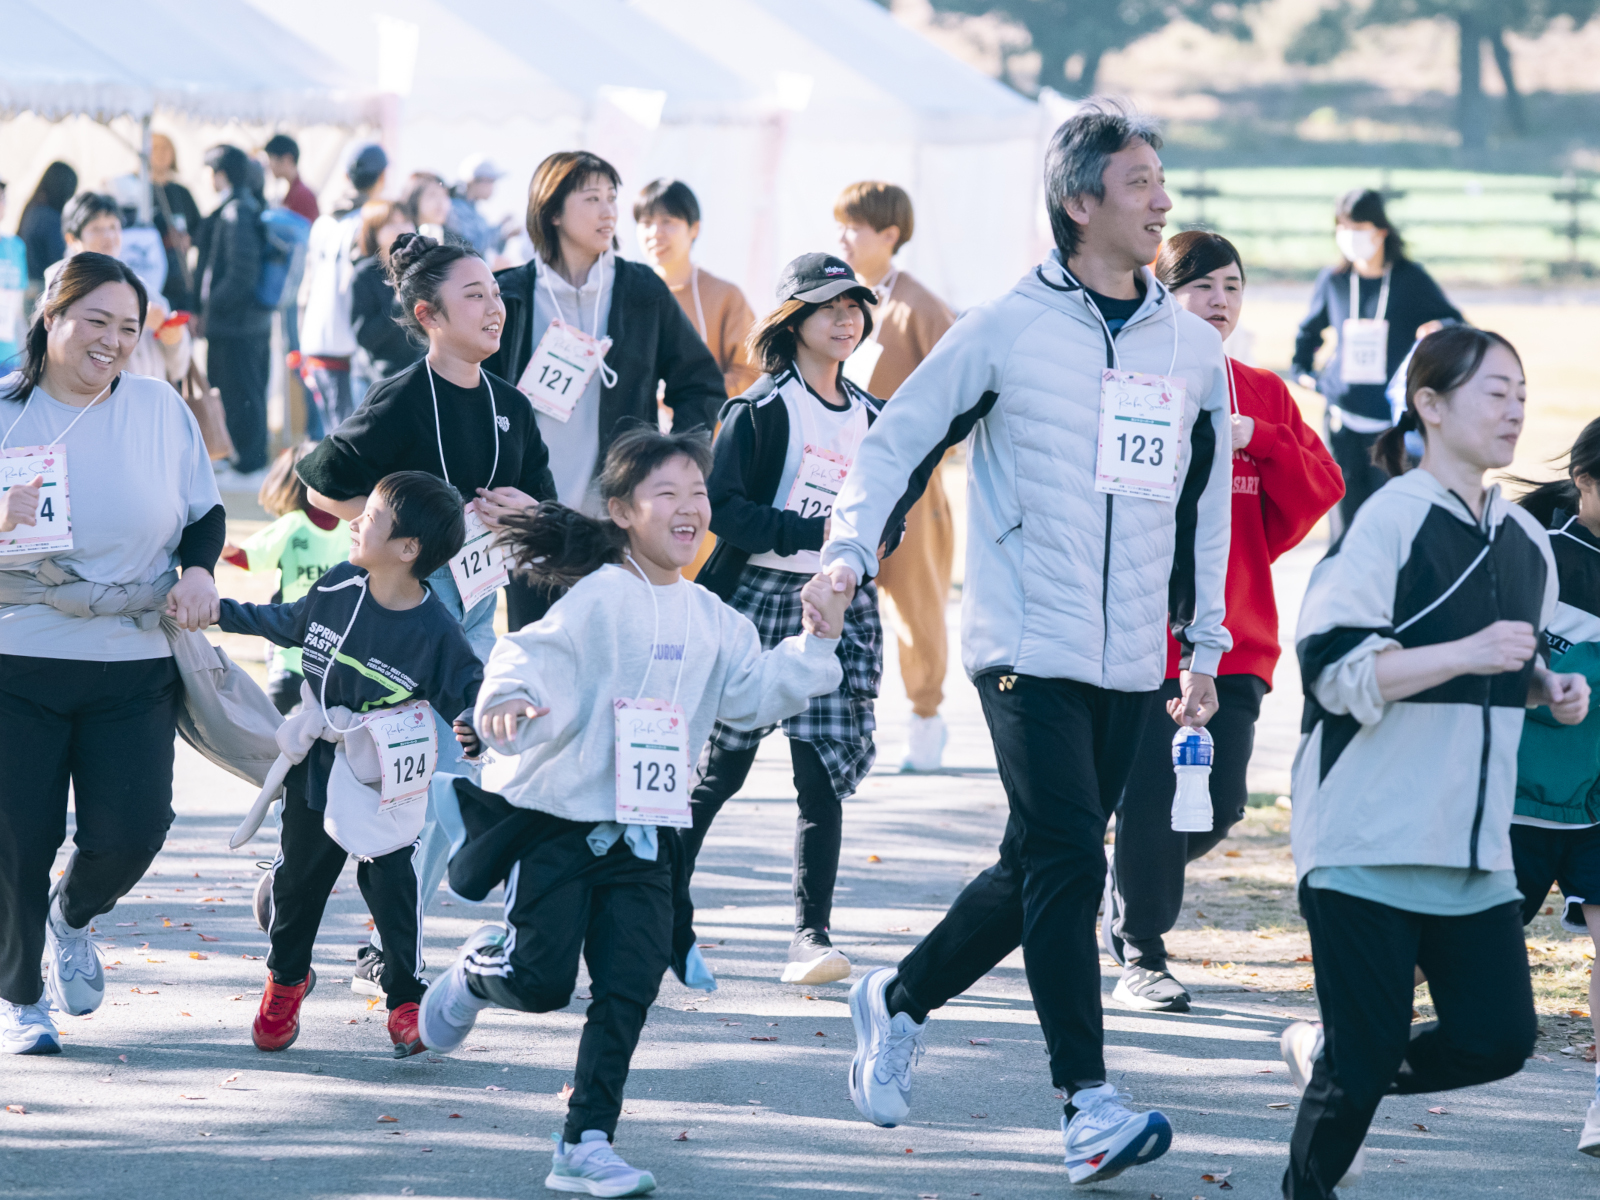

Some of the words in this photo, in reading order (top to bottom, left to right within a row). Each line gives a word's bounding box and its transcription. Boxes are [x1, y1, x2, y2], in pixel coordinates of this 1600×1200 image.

[538, 364, 573, 395] 121
[1117, 432, 1164, 466] 123
[460, 544, 491, 579] 121
[304, 632, 332, 652] FAST
[309, 621, 344, 646] SPRINT
[394, 753, 425, 784] 124
[633, 760, 676, 792] 123
